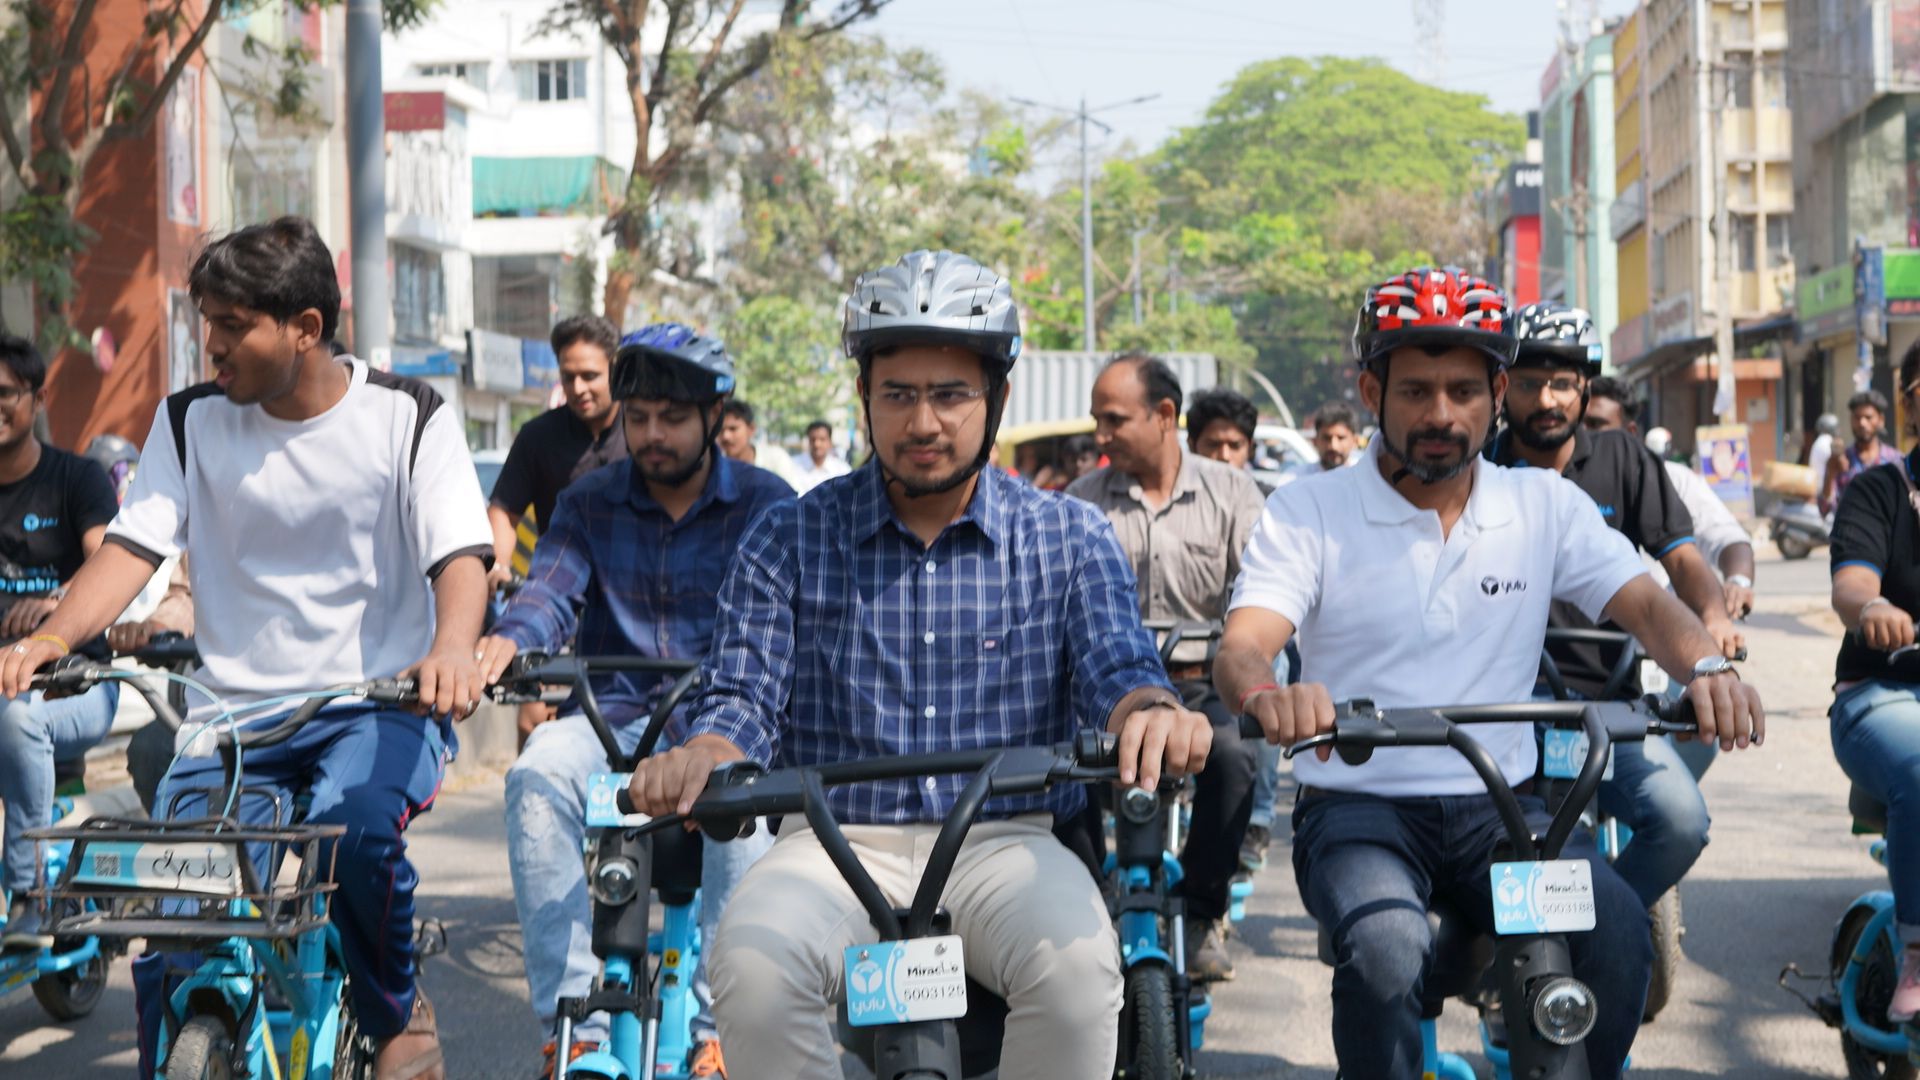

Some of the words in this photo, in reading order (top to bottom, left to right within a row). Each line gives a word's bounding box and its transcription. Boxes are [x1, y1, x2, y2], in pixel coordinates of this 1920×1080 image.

[1501, 580, 1527, 594] yulu
[1499, 909, 1528, 926] yulu
[852, 997, 886, 1017] yulu
